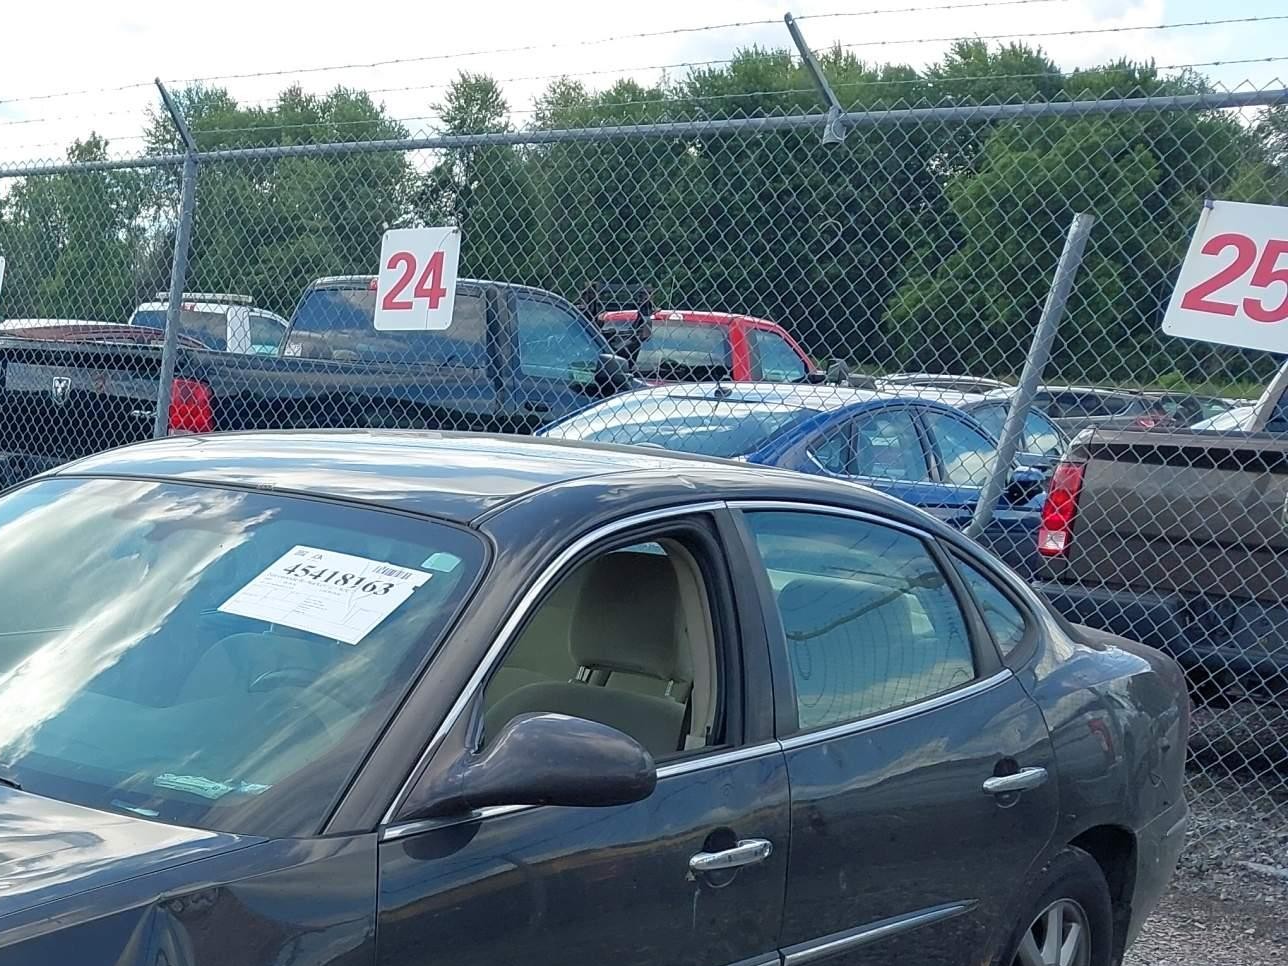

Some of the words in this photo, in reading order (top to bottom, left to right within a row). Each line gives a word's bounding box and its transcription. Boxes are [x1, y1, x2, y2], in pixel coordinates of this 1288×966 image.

[382, 250, 446, 310] 24
[1180, 233, 1288, 323] 25
[283, 563, 394, 595] 45418163
